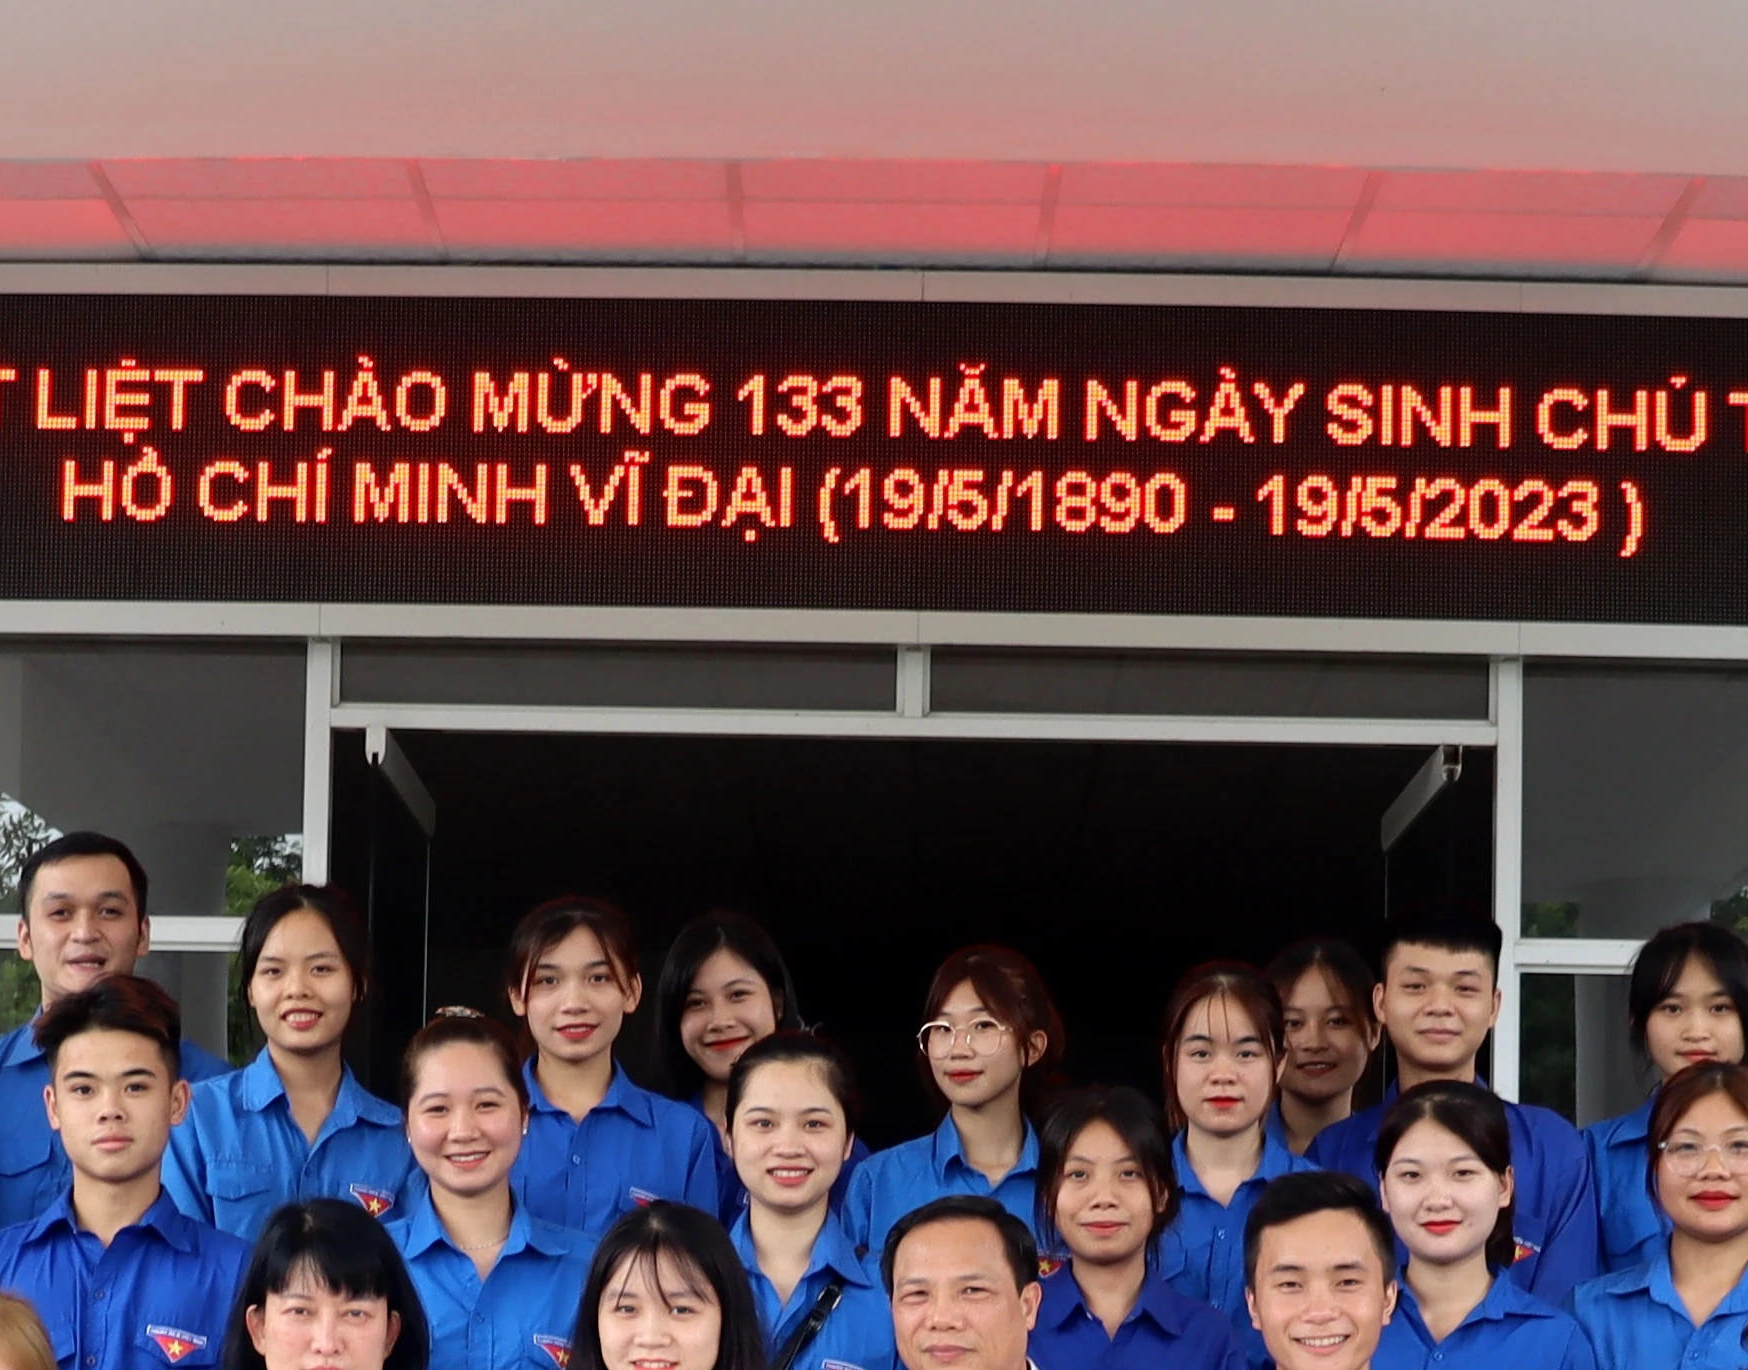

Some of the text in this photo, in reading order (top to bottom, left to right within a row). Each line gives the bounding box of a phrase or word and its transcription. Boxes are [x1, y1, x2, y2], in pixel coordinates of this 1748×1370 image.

[35, 358, 206, 443] LIỆT
[223, 355, 449, 432] CHÀO
[471, 357, 712, 436] MỪNG
[737, 373, 864, 438] 133
[887, 363, 1060, 440] NĂM
[1084, 366, 1305, 444] NGÀY
[1326, 383, 1511, 449] SINH
[1536, 376, 1708, 452] CHỦ
[63, 447, 173, 522] HỒ
[197, 447, 332, 524] CHÍ
[352, 461, 550, 526] MINH
[569, 449, 652, 526] VĨ
[662, 464, 794, 542] ĐẠI
[817, 467, 1187, 543] (19/5/1890
[1256, 474, 1599, 542] 19/5/2023
